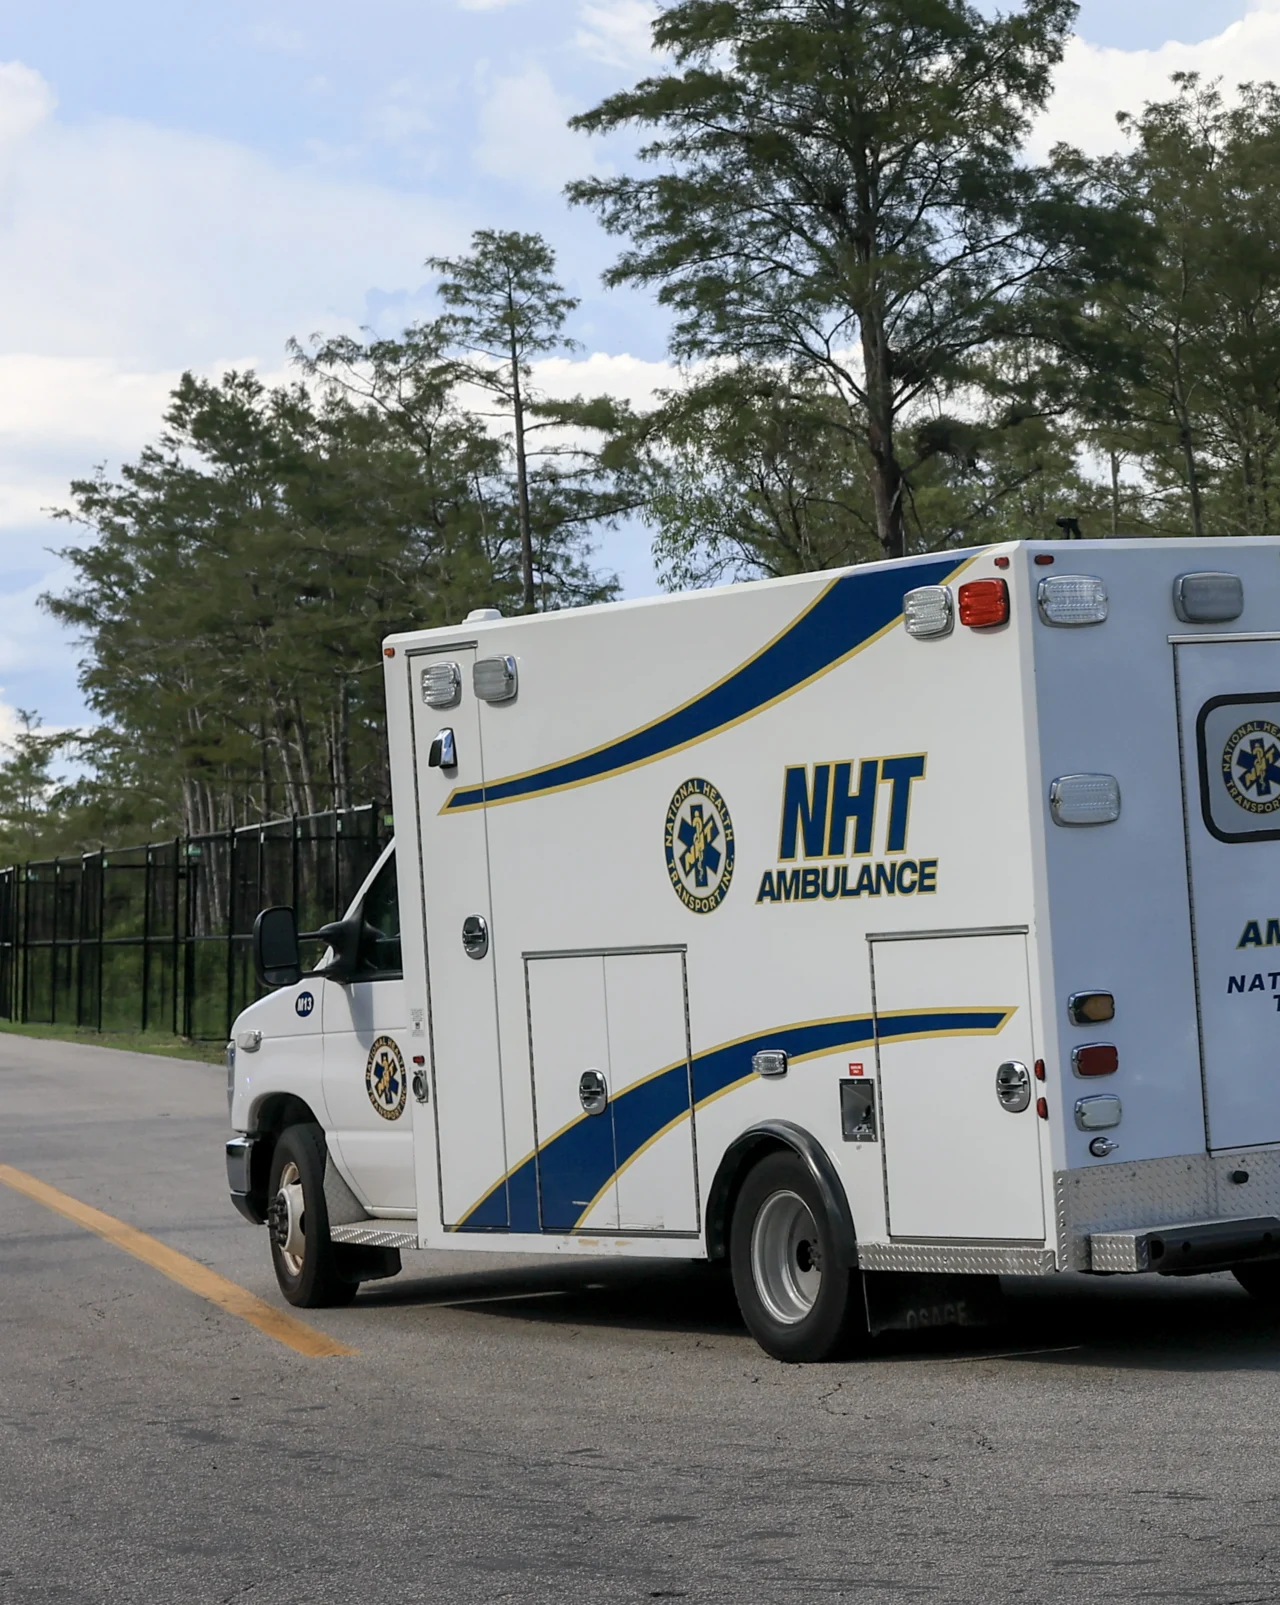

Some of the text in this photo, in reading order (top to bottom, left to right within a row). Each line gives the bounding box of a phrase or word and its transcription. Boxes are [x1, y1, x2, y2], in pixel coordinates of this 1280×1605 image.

[1223, 722, 1260, 772] NATIONAL
[665, 780, 733, 847] NATIONAL HEALTH
[777, 752, 928, 863] NHT
[668, 855, 734, 912] TRANSPORT INC.
[755, 857, 939, 905] AMBULANCE
[297, 997, 312, 1011] M13
